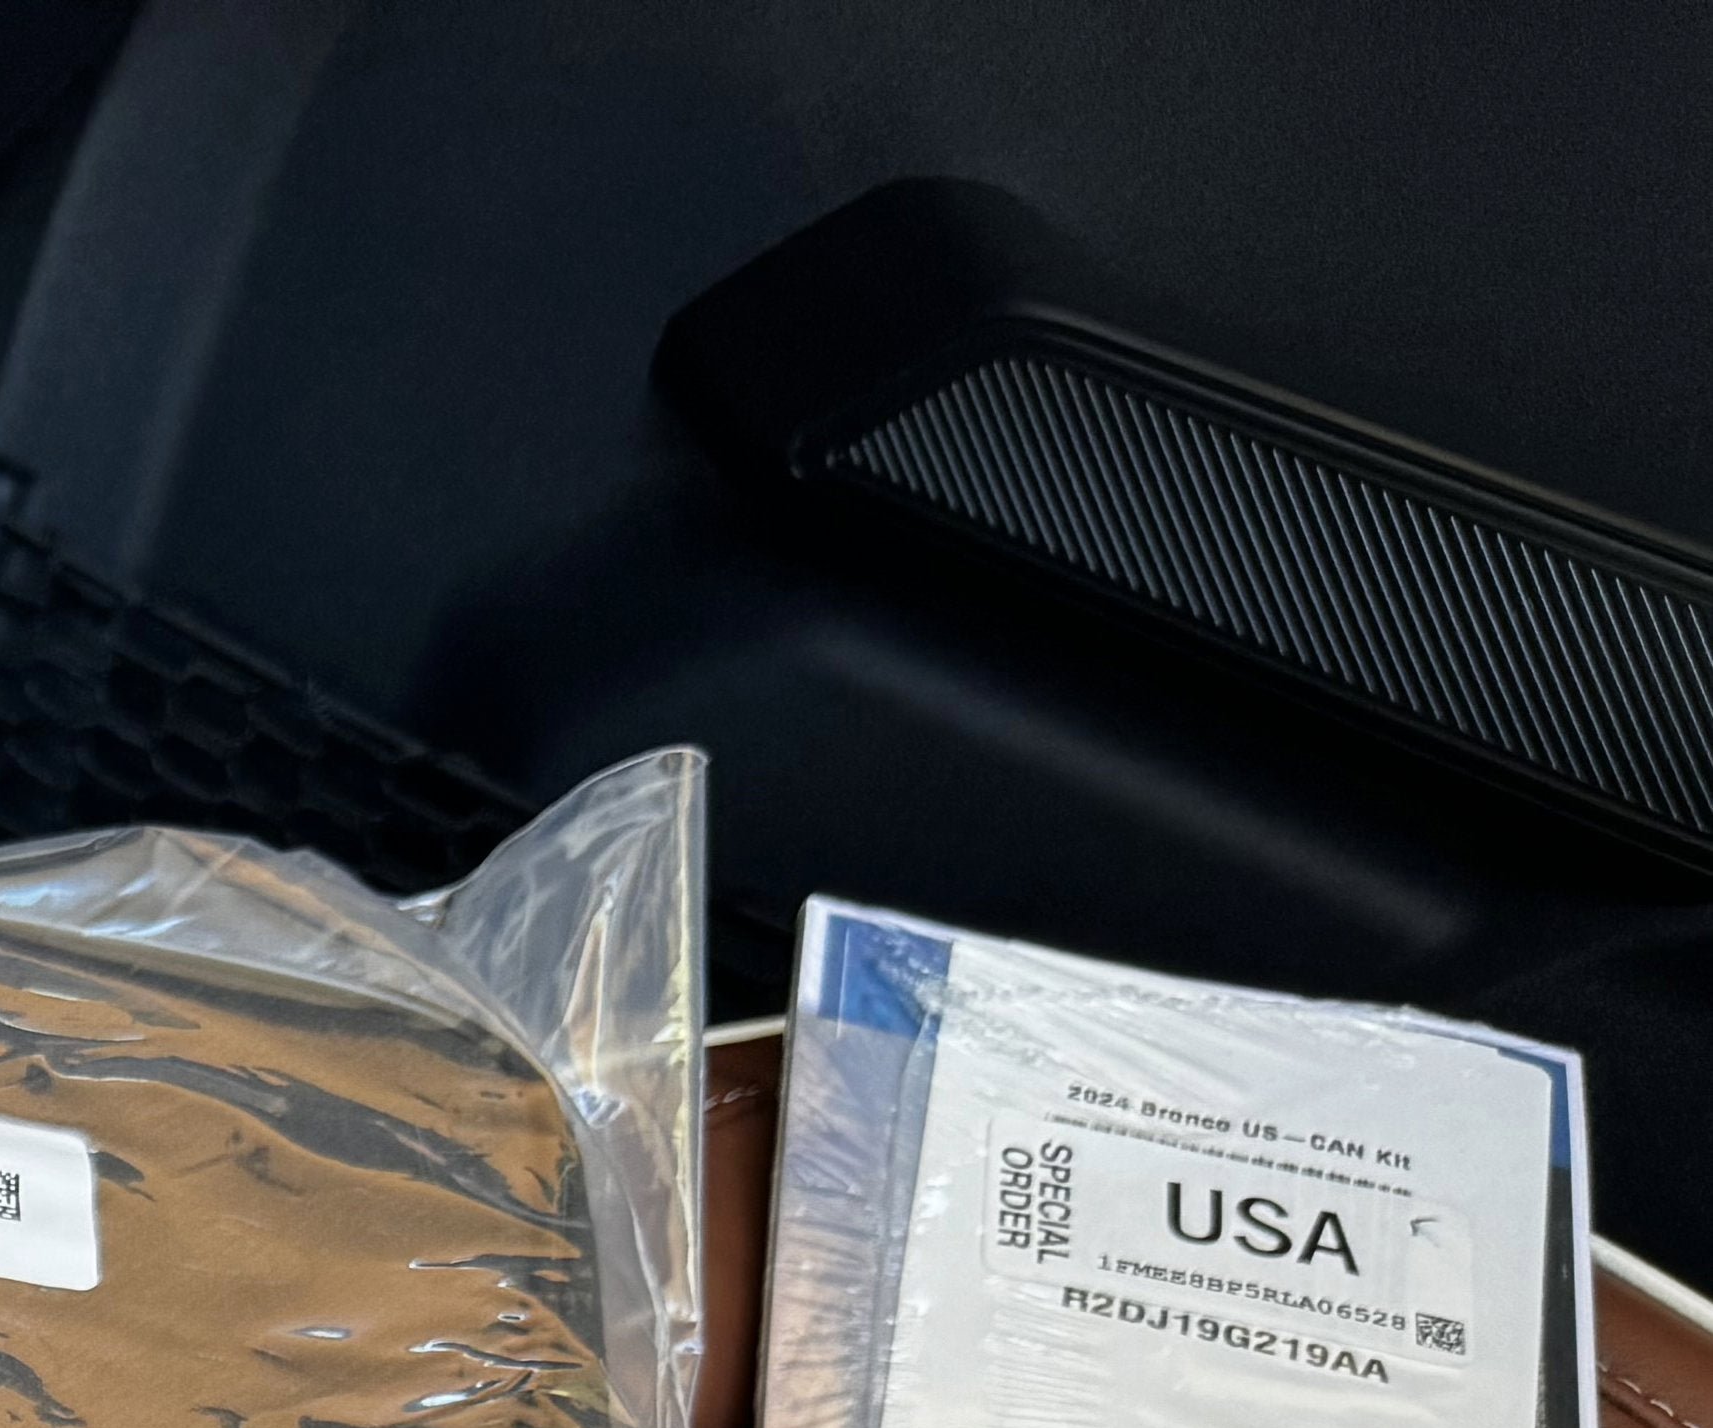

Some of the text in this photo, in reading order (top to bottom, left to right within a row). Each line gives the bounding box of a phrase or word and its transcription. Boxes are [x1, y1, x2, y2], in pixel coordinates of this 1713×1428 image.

[1067, 1084, 1130, 1112] 2024
[1140, 1100, 1232, 1133] Bronco
[1376, 1149, 1413, 1172] Kit
[997, 1146, 1034, 1250] ORDER
[1036, 1137, 1074, 1265] SPECIAL
[1165, 1181, 1361, 1277] USA
[1061, 1286, 1390, 1385] R2DJ19G219AA
